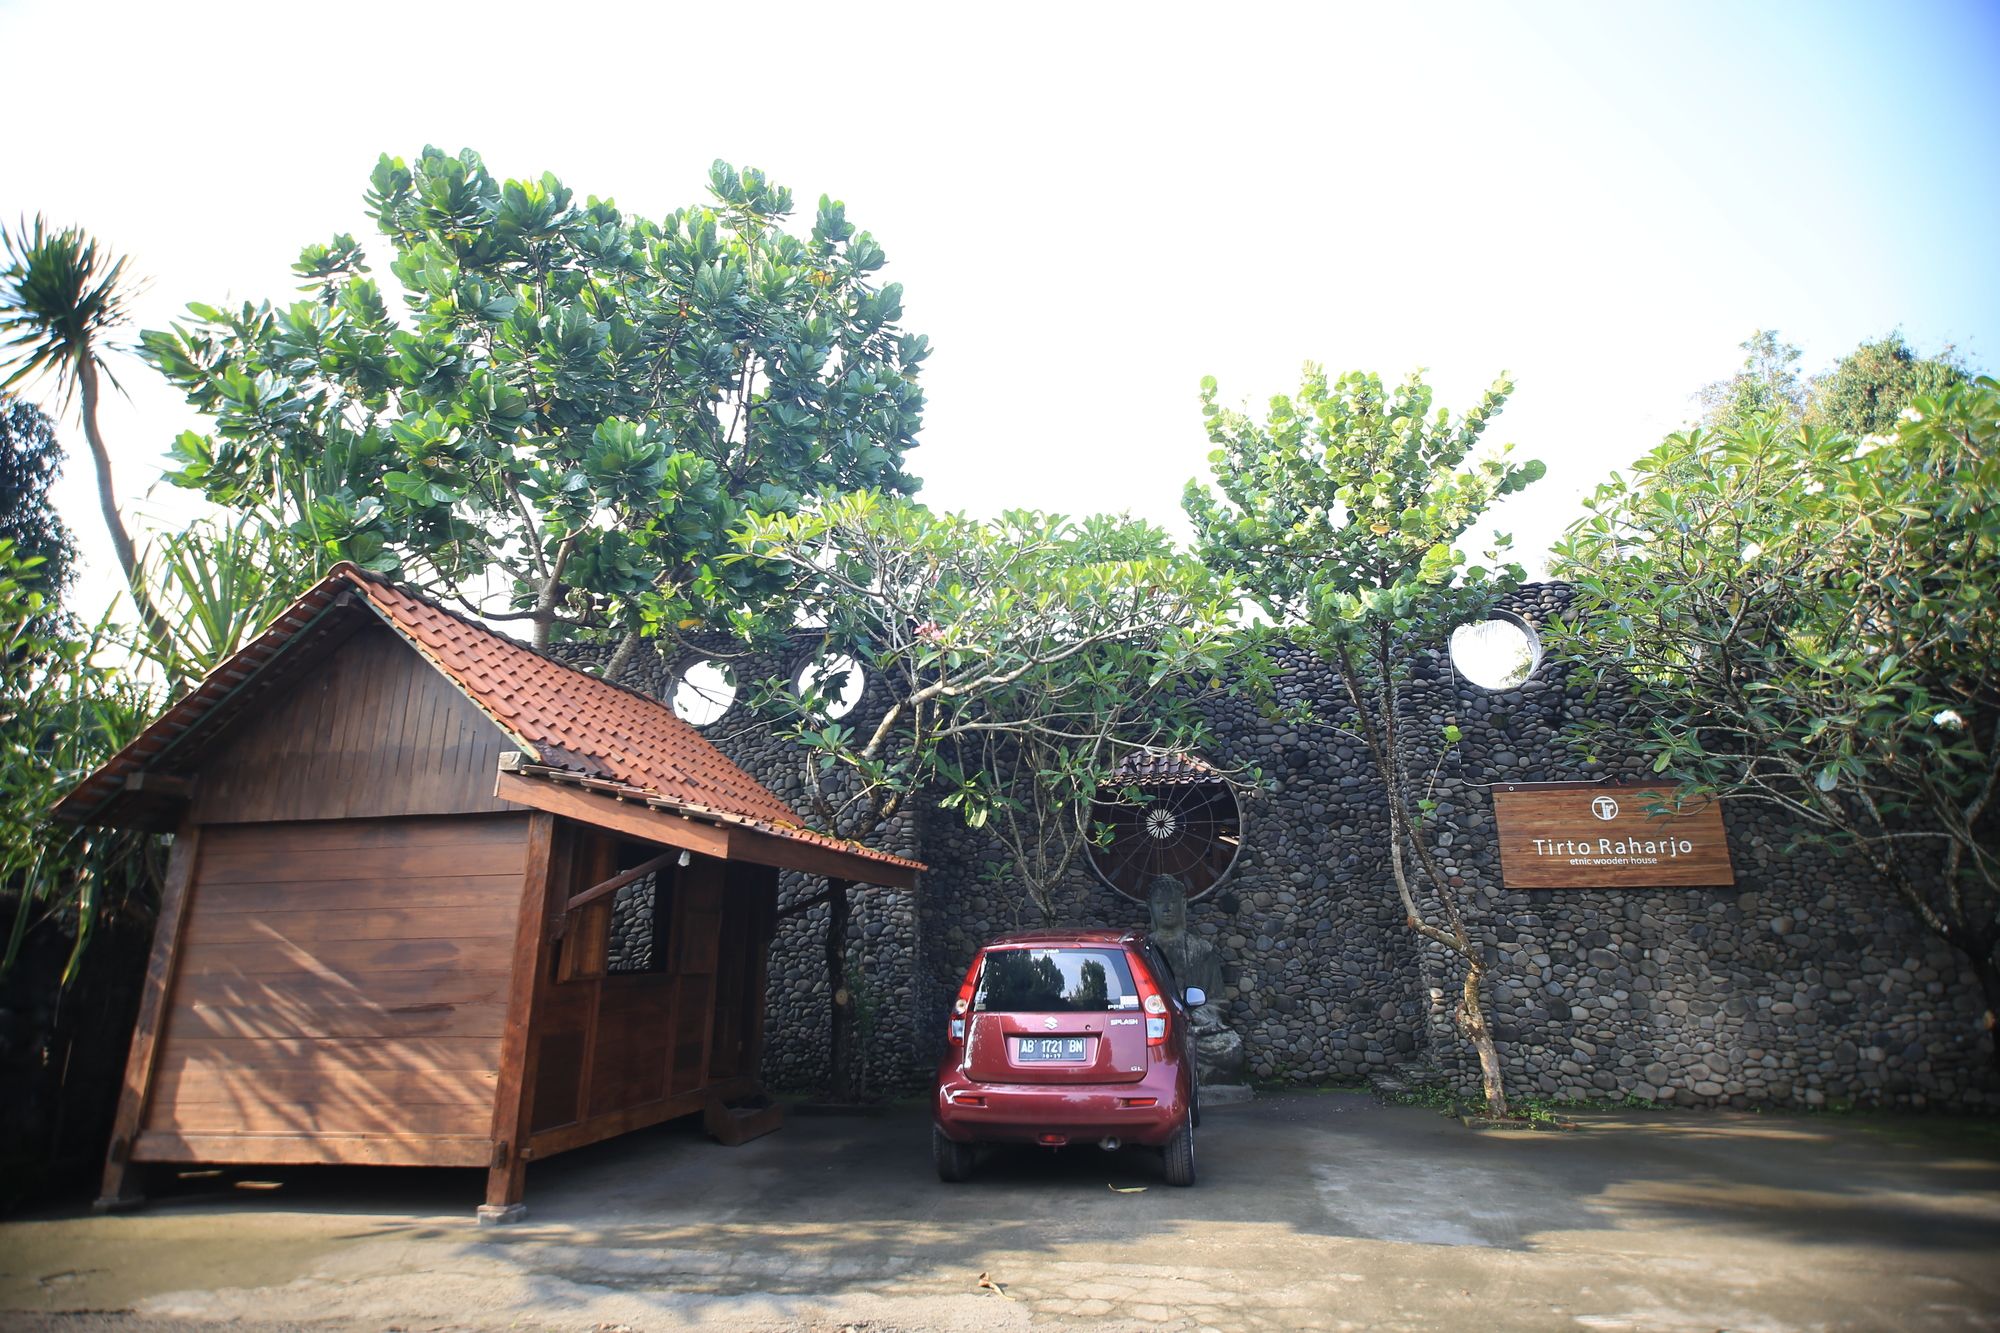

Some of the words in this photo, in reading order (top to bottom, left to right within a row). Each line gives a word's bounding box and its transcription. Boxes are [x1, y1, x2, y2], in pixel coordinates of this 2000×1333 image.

[1533, 839, 1591, 856] Tirto
[1599, 837, 1692, 857] Raharjo
[1570, 857, 1592, 865] etnic
[1593, 857, 1629, 865] wooden
[1630, 856, 1658, 865] house
[1110, 1018, 1138, 1026] SPLASH
[1021, 1039, 1035, 1053] AB
[1041, 1039, 1063, 1053] 1721
[1069, 1039, 1083, 1053] BN
